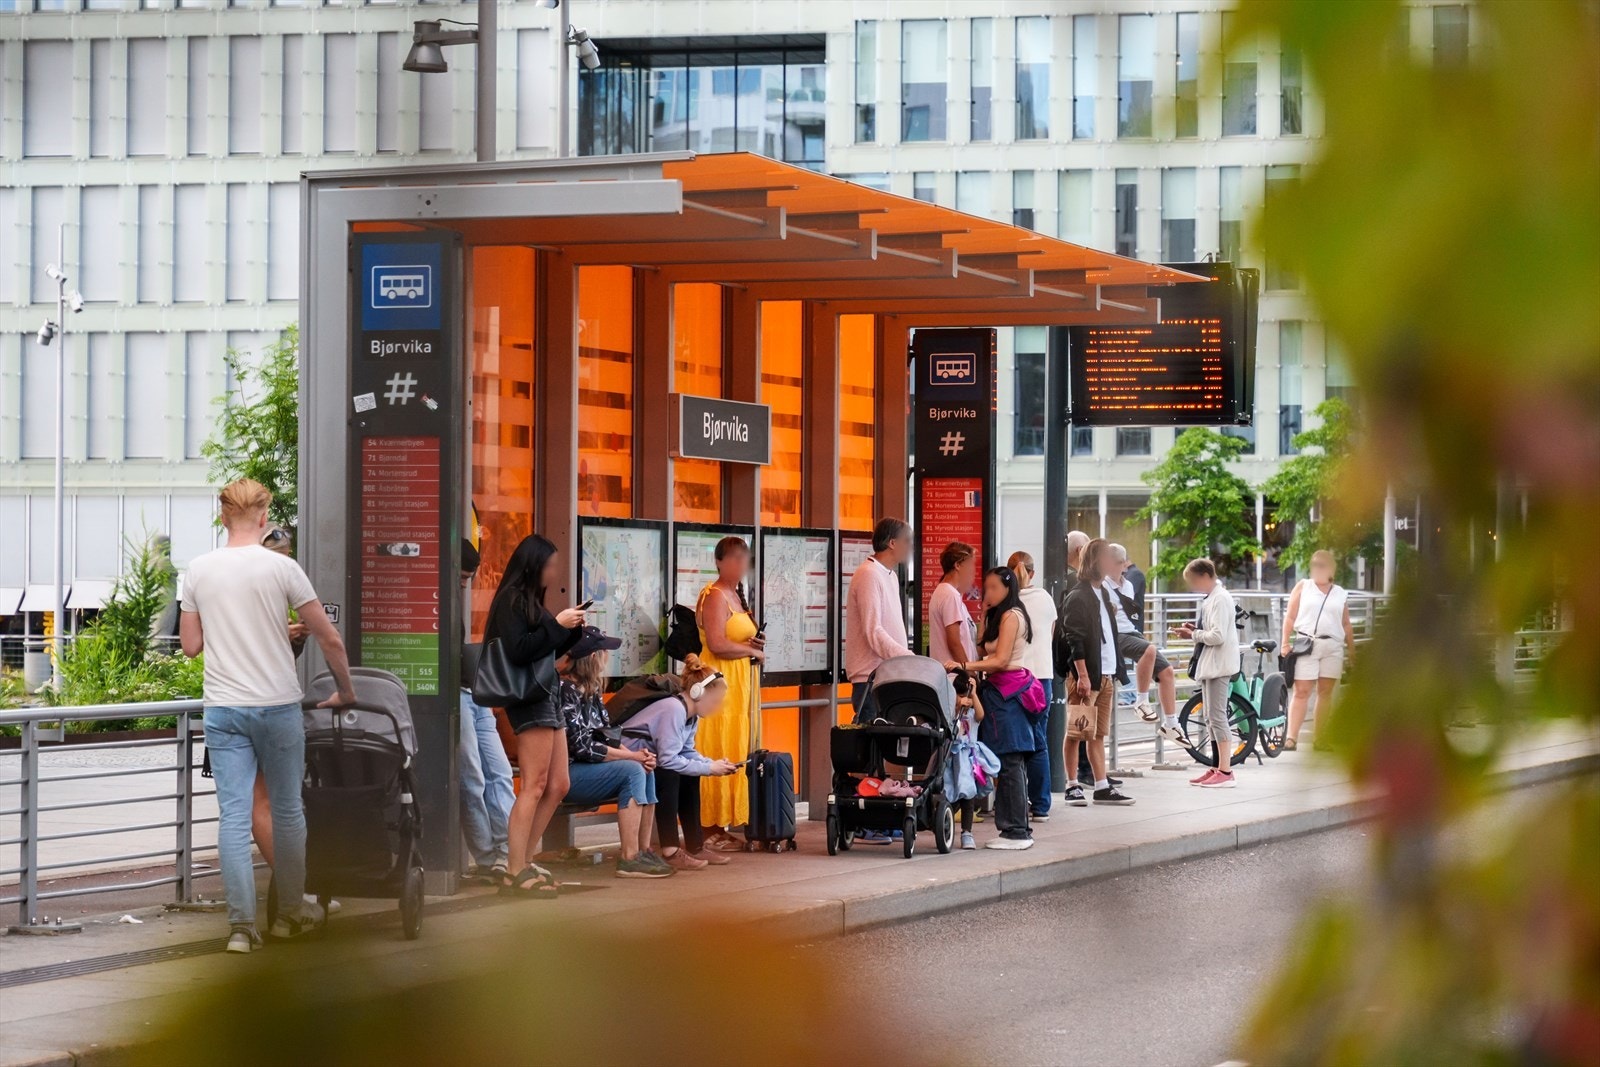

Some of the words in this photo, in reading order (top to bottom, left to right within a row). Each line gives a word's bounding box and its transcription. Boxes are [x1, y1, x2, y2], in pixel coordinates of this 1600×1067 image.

[370, 339, 432, 357] Bjørvika
[930, 408, 977, 421] Bjørvika
[703, 411, 749, 446] Bjørvika
[367, 469, 376, 477] 74
[379, 469, 418, 477] Mortensrud
[404, 500, 429, 508] stasjon
[367, 515, 375, 523] 83
[412, 531, 435, 540] stasjon
[388, 607, 413, 616] stasjon
[393, 637, 421, 645] lufthavn
[419, 668, 433, 676] 515
[417, 683, 436, 691] 540N
